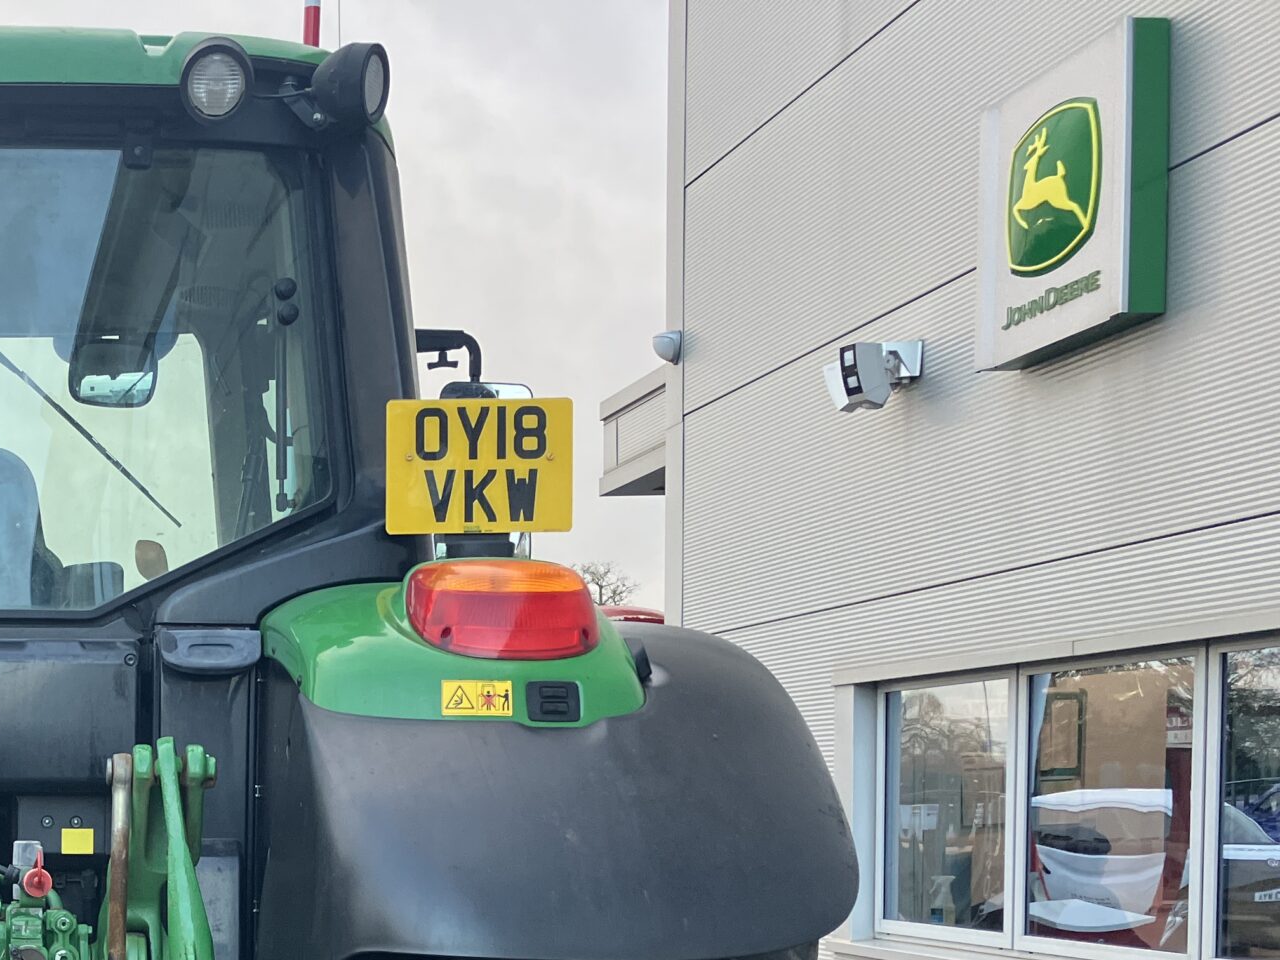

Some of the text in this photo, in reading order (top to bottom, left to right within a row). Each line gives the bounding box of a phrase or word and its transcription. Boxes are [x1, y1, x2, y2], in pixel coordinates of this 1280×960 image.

[1001, 270, 1102, 331] JOHN DEERE
[415, 405, 547, 461] OY18
[423, 468, 538, 523] VKW
